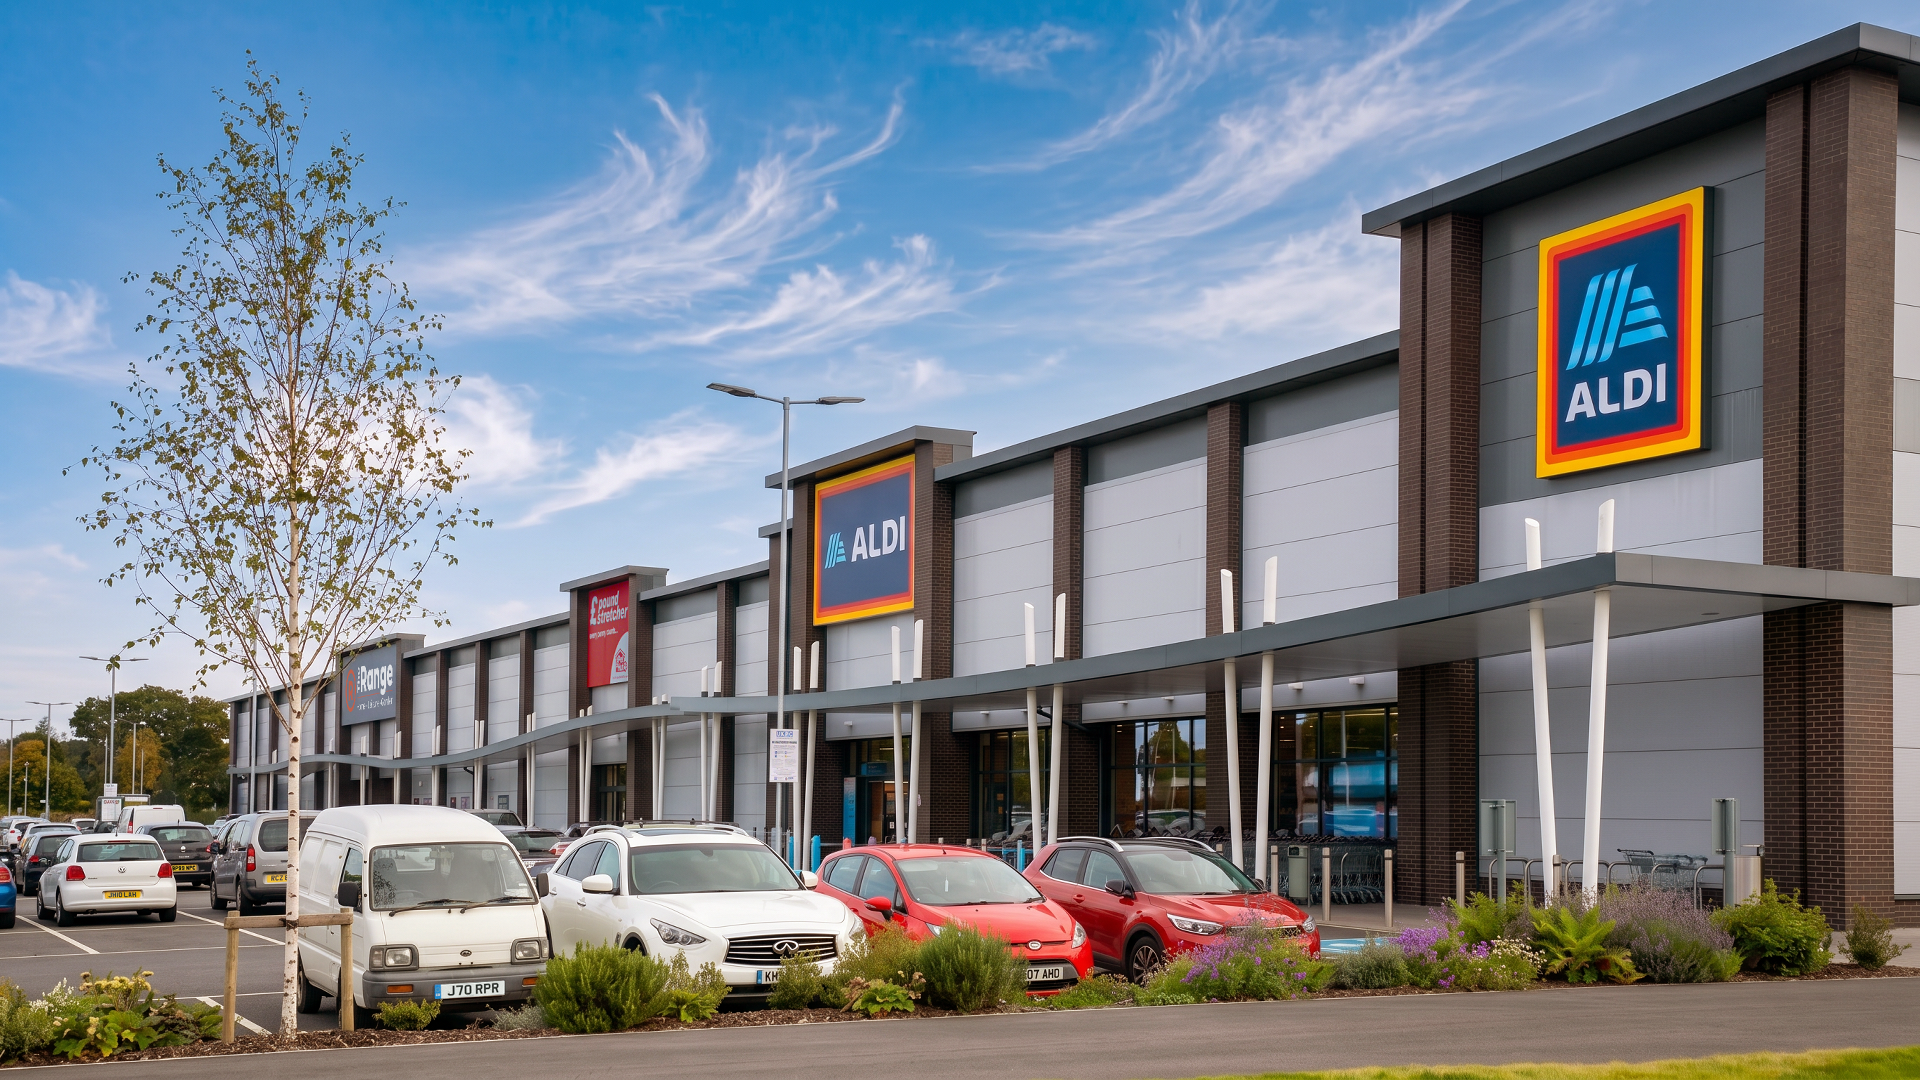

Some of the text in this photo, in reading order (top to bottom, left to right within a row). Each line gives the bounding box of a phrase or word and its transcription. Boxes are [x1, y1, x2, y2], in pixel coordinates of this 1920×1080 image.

[1565, 362, 1667, 423] ALDI
[851, 515, 906, 562] ALDI
[598, 590, 620, 614] pound
[597, 605, 629, 625] stretcher
[360, 664, 393, 696] Range
[270, 874, 284, 882] RCZ
[447, 982, 499, 997] J70 RPR
